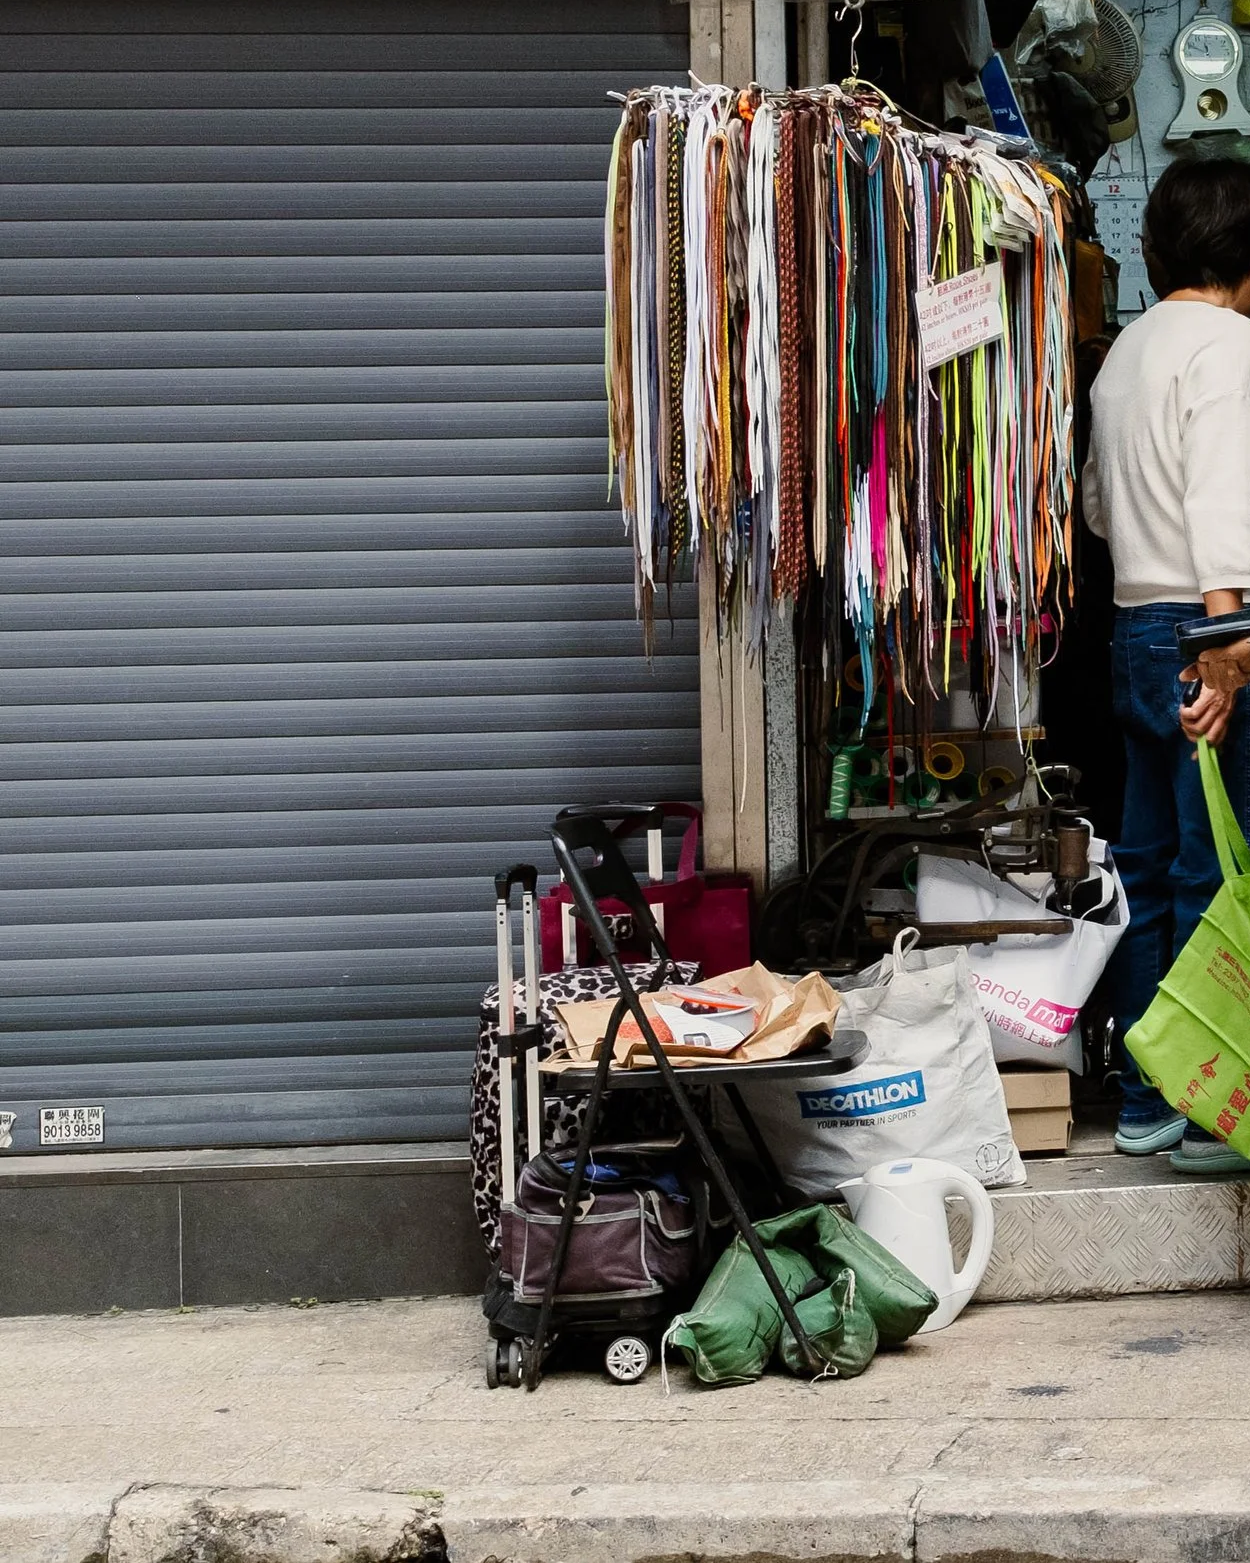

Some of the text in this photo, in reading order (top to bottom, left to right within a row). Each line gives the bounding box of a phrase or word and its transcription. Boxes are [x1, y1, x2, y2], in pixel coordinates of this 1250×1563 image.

[1107, 184, 1120, 193] 12
[805, 1078, 919, 1114] DECATHLON
[816, 1118, 839, 1130] YOUR
[886, 1108, 918, 1124] SPORTS
[43, 1123, 101, 1139] 9013 9858
